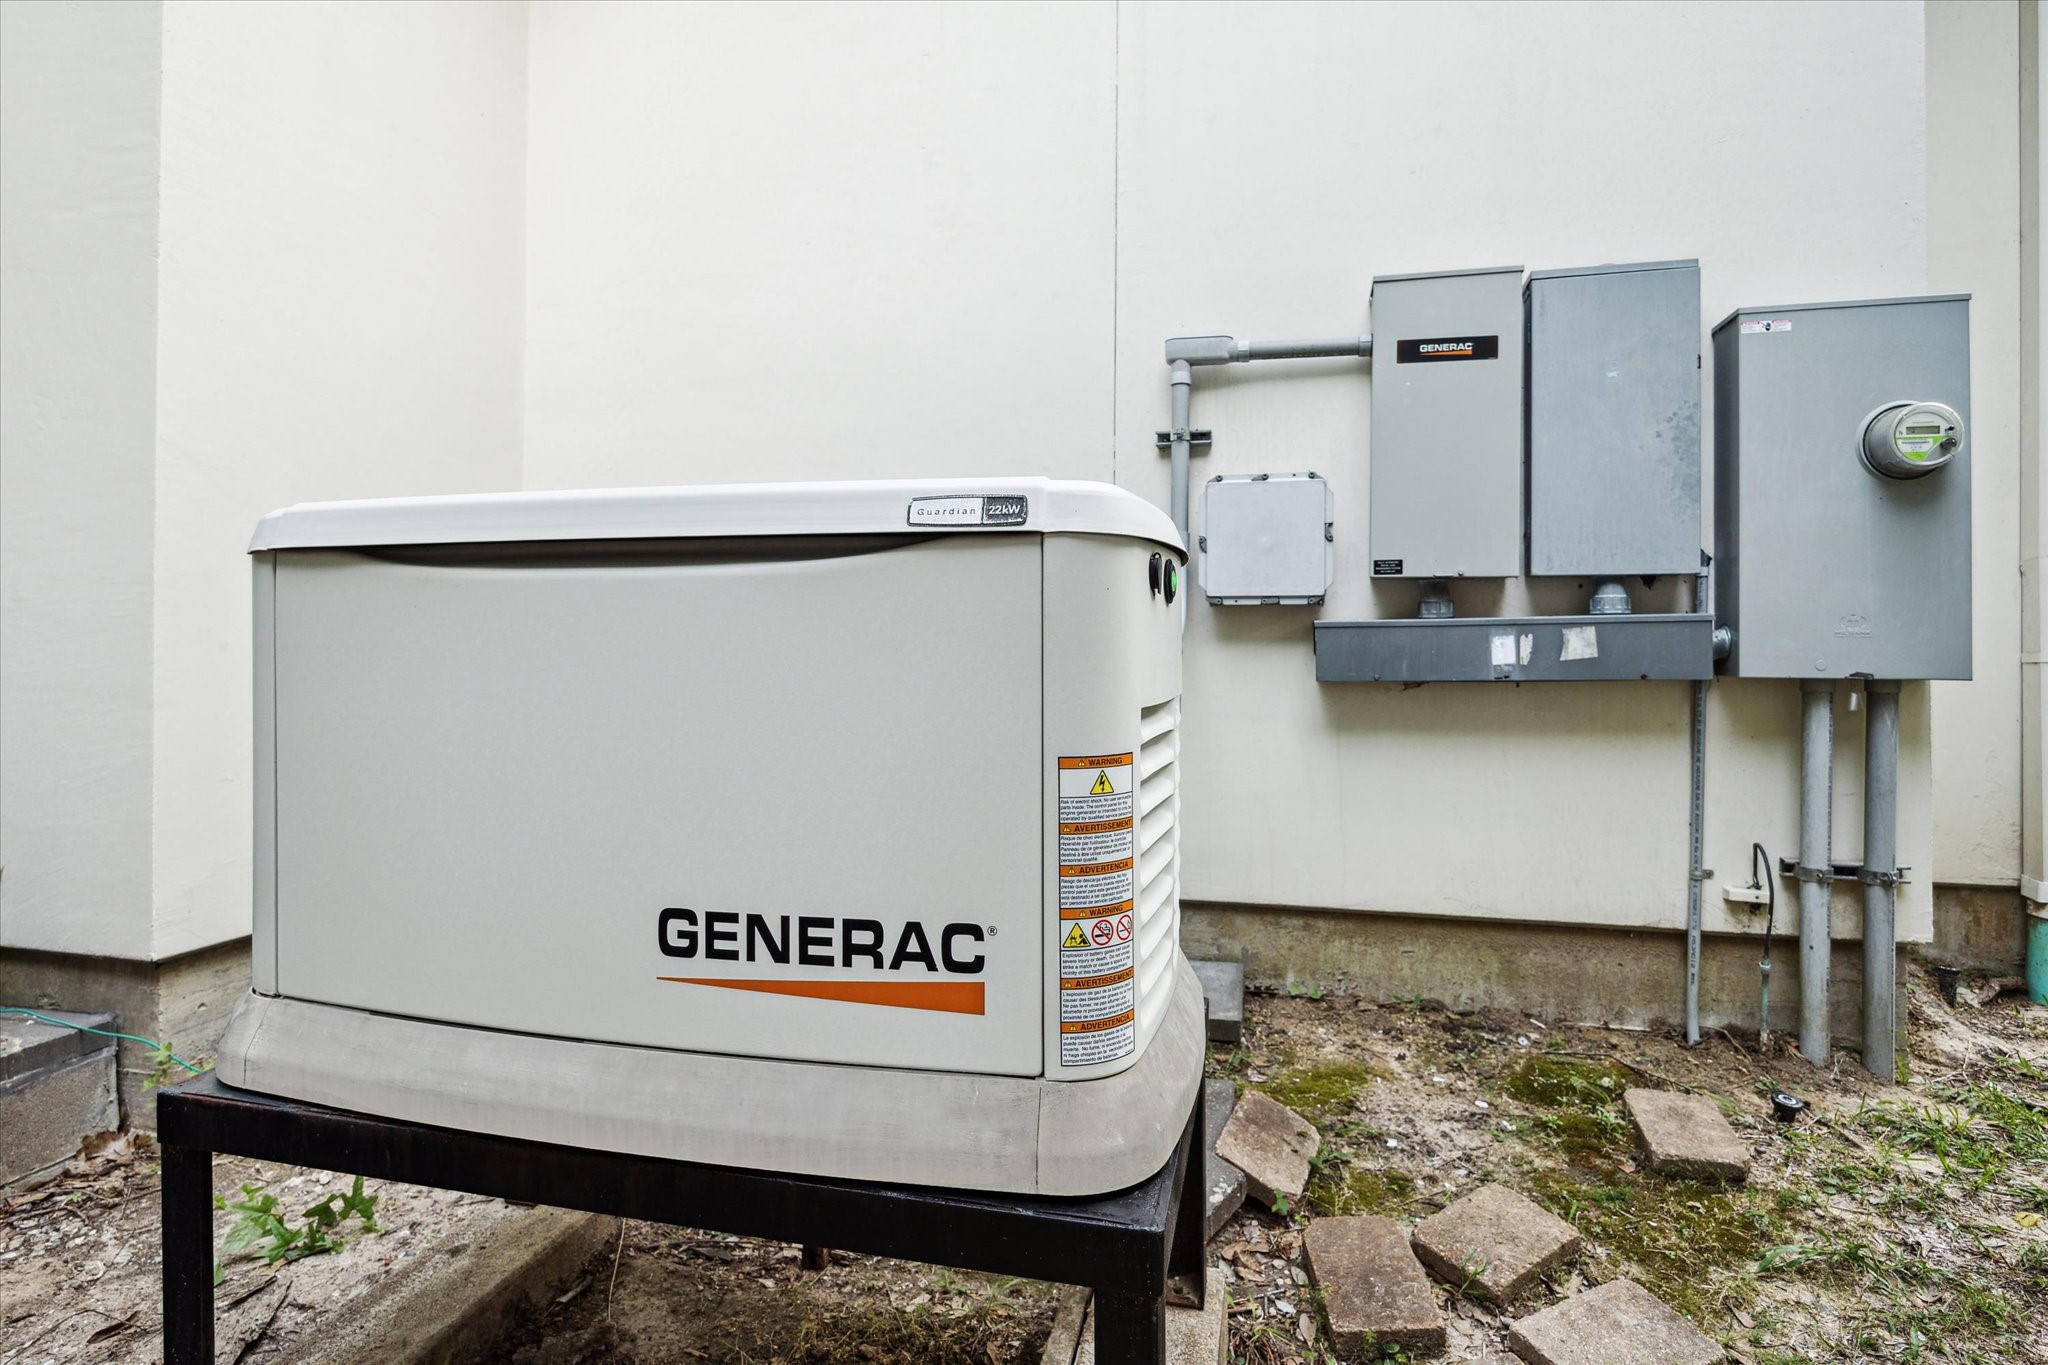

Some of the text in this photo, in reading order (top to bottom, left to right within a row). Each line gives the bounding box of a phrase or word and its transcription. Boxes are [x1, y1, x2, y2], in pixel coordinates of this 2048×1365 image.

[1420, 342, 1472, 352] GENERAC
[917, 504, 1020, 516] Guardian 22kW
[1088, 757, 1122, 766] WARNING
[1074, 820, 1131, 832] AVERTISSEMENT
[1079, 860, 1128, 874] ADVERTENCIA
[1089, 905, 1123, 916] WARNING
[658, 906, 986, 974] GENERAC
[1075, 970, 1132, 987] AVERTISSEMENT
[1081, 1014, 1130, 1030] ADVERTENCIA
